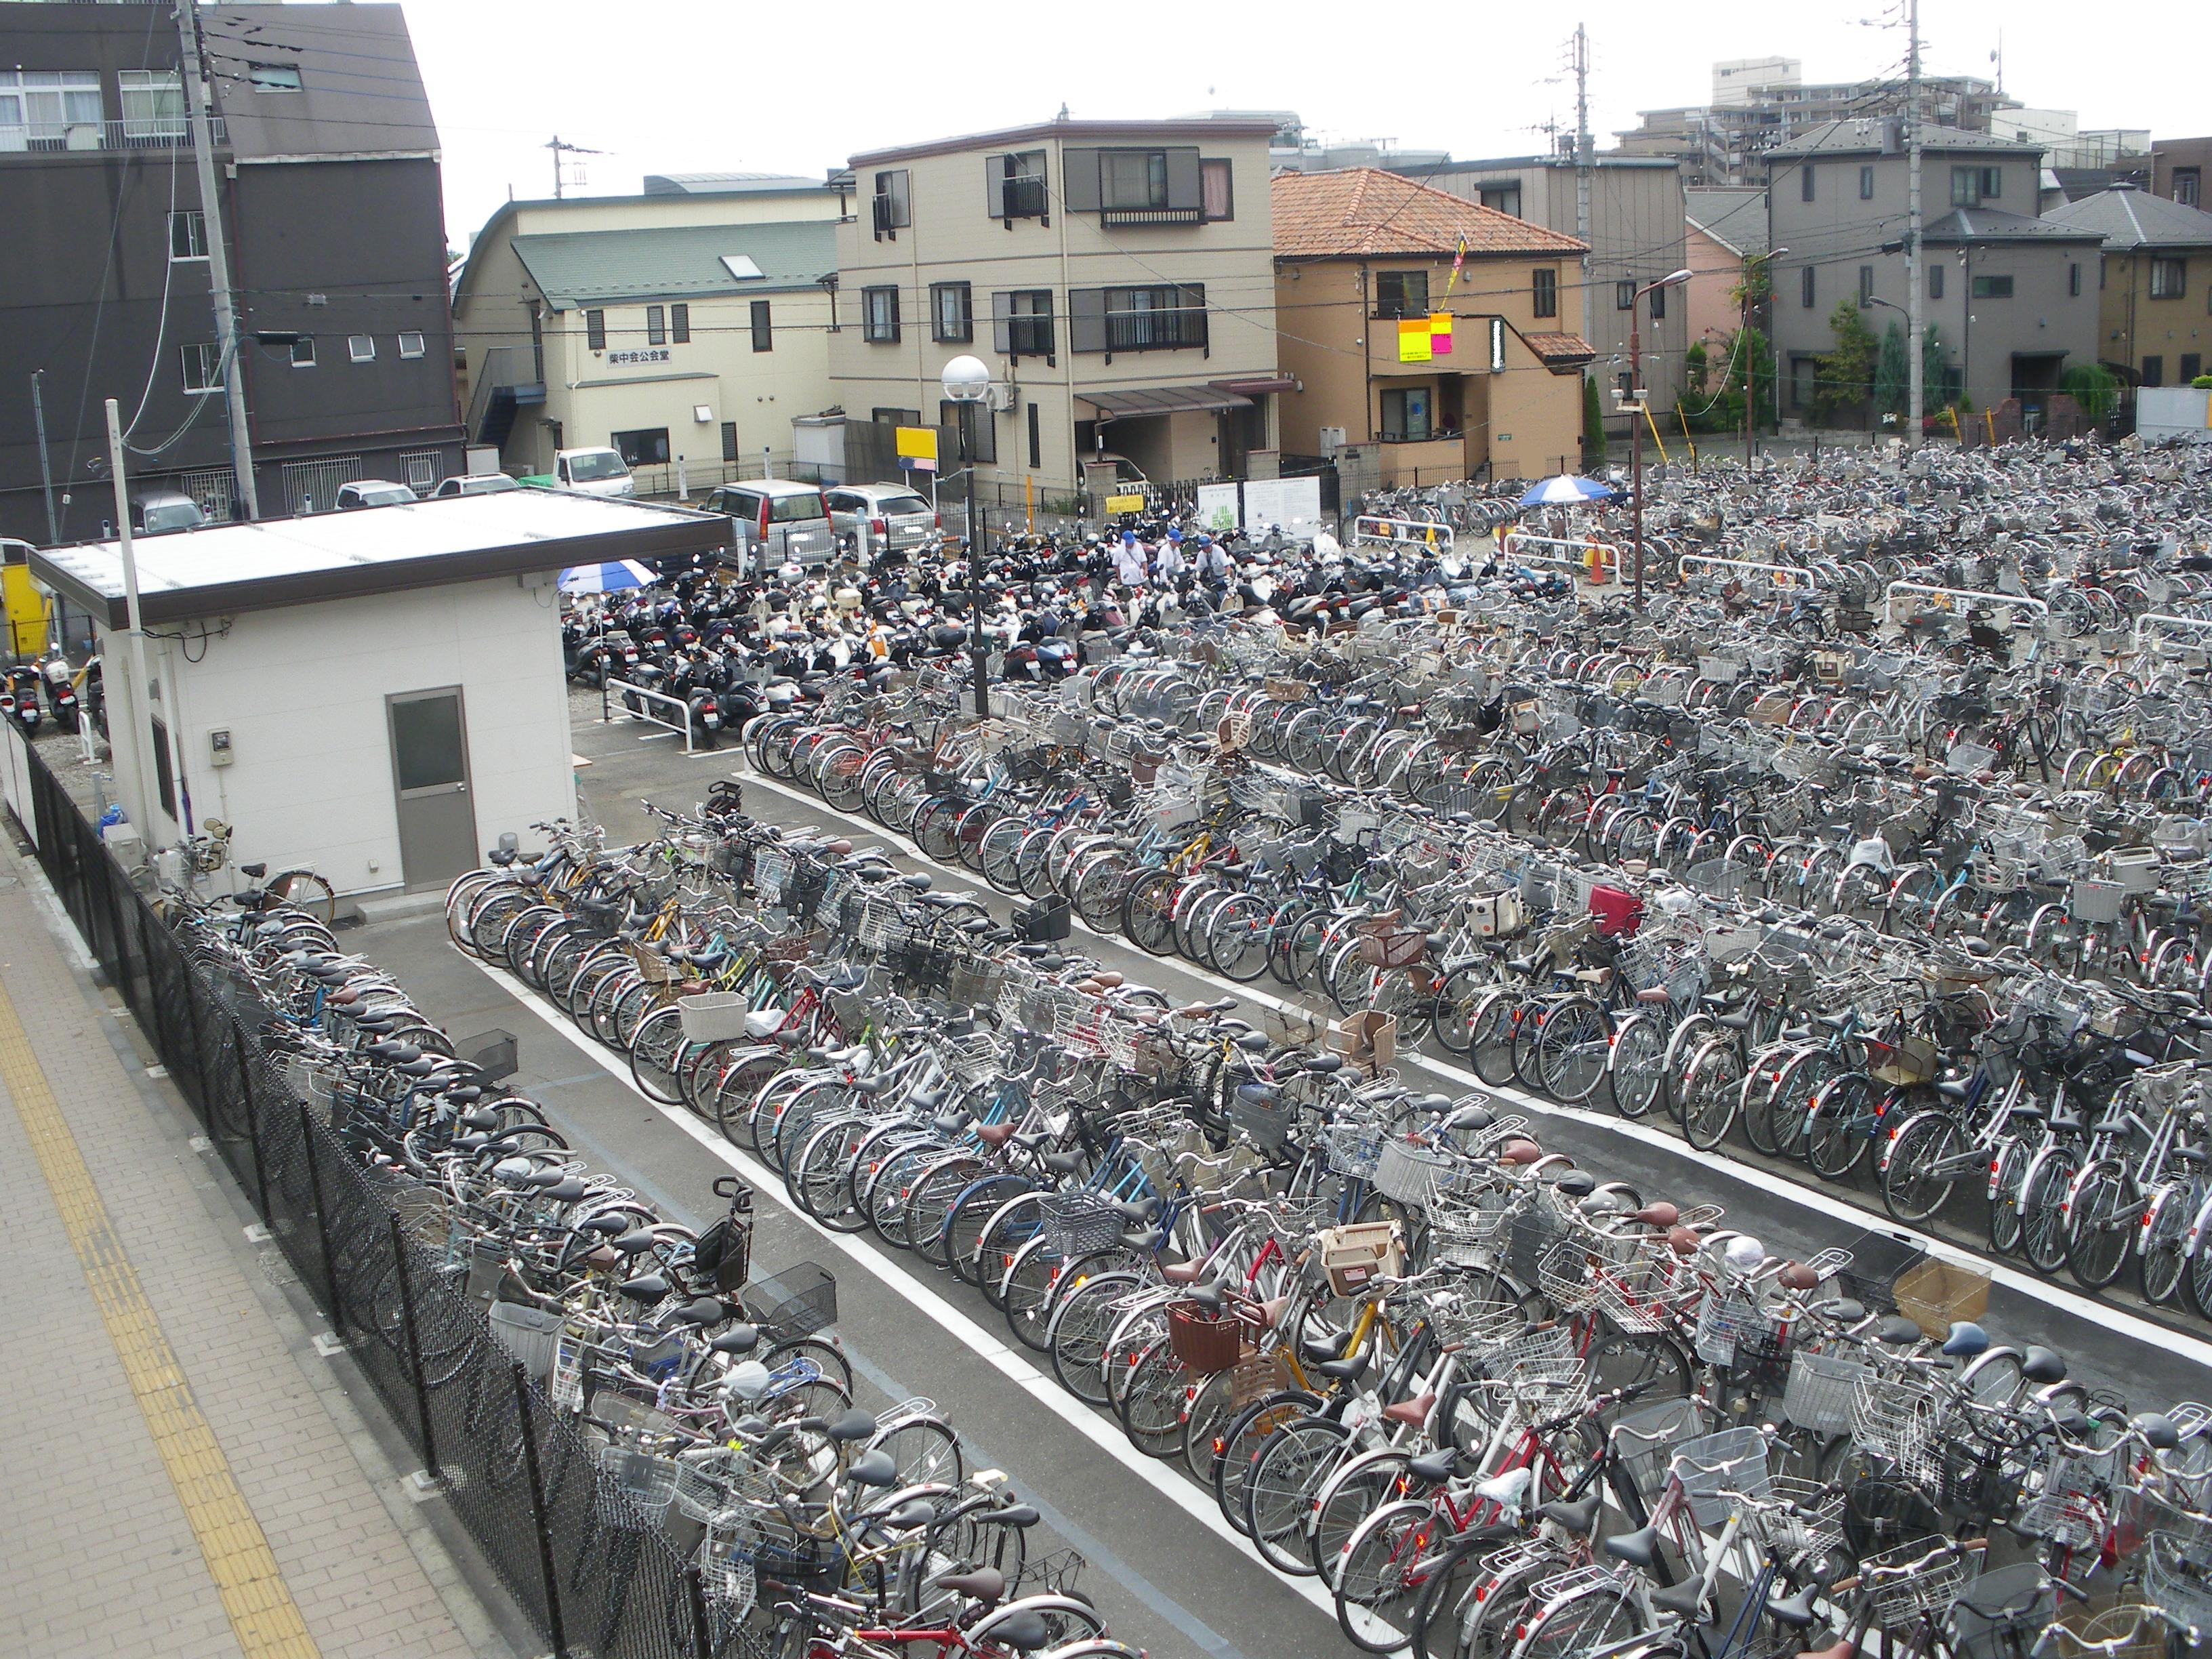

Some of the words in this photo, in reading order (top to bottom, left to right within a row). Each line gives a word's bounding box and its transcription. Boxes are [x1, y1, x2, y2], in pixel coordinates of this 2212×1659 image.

[609, 350, 669, 364] 柴中会公会堂
[1556, 547, 1563, 558] H
[1960, 600, 1966, 613] F
